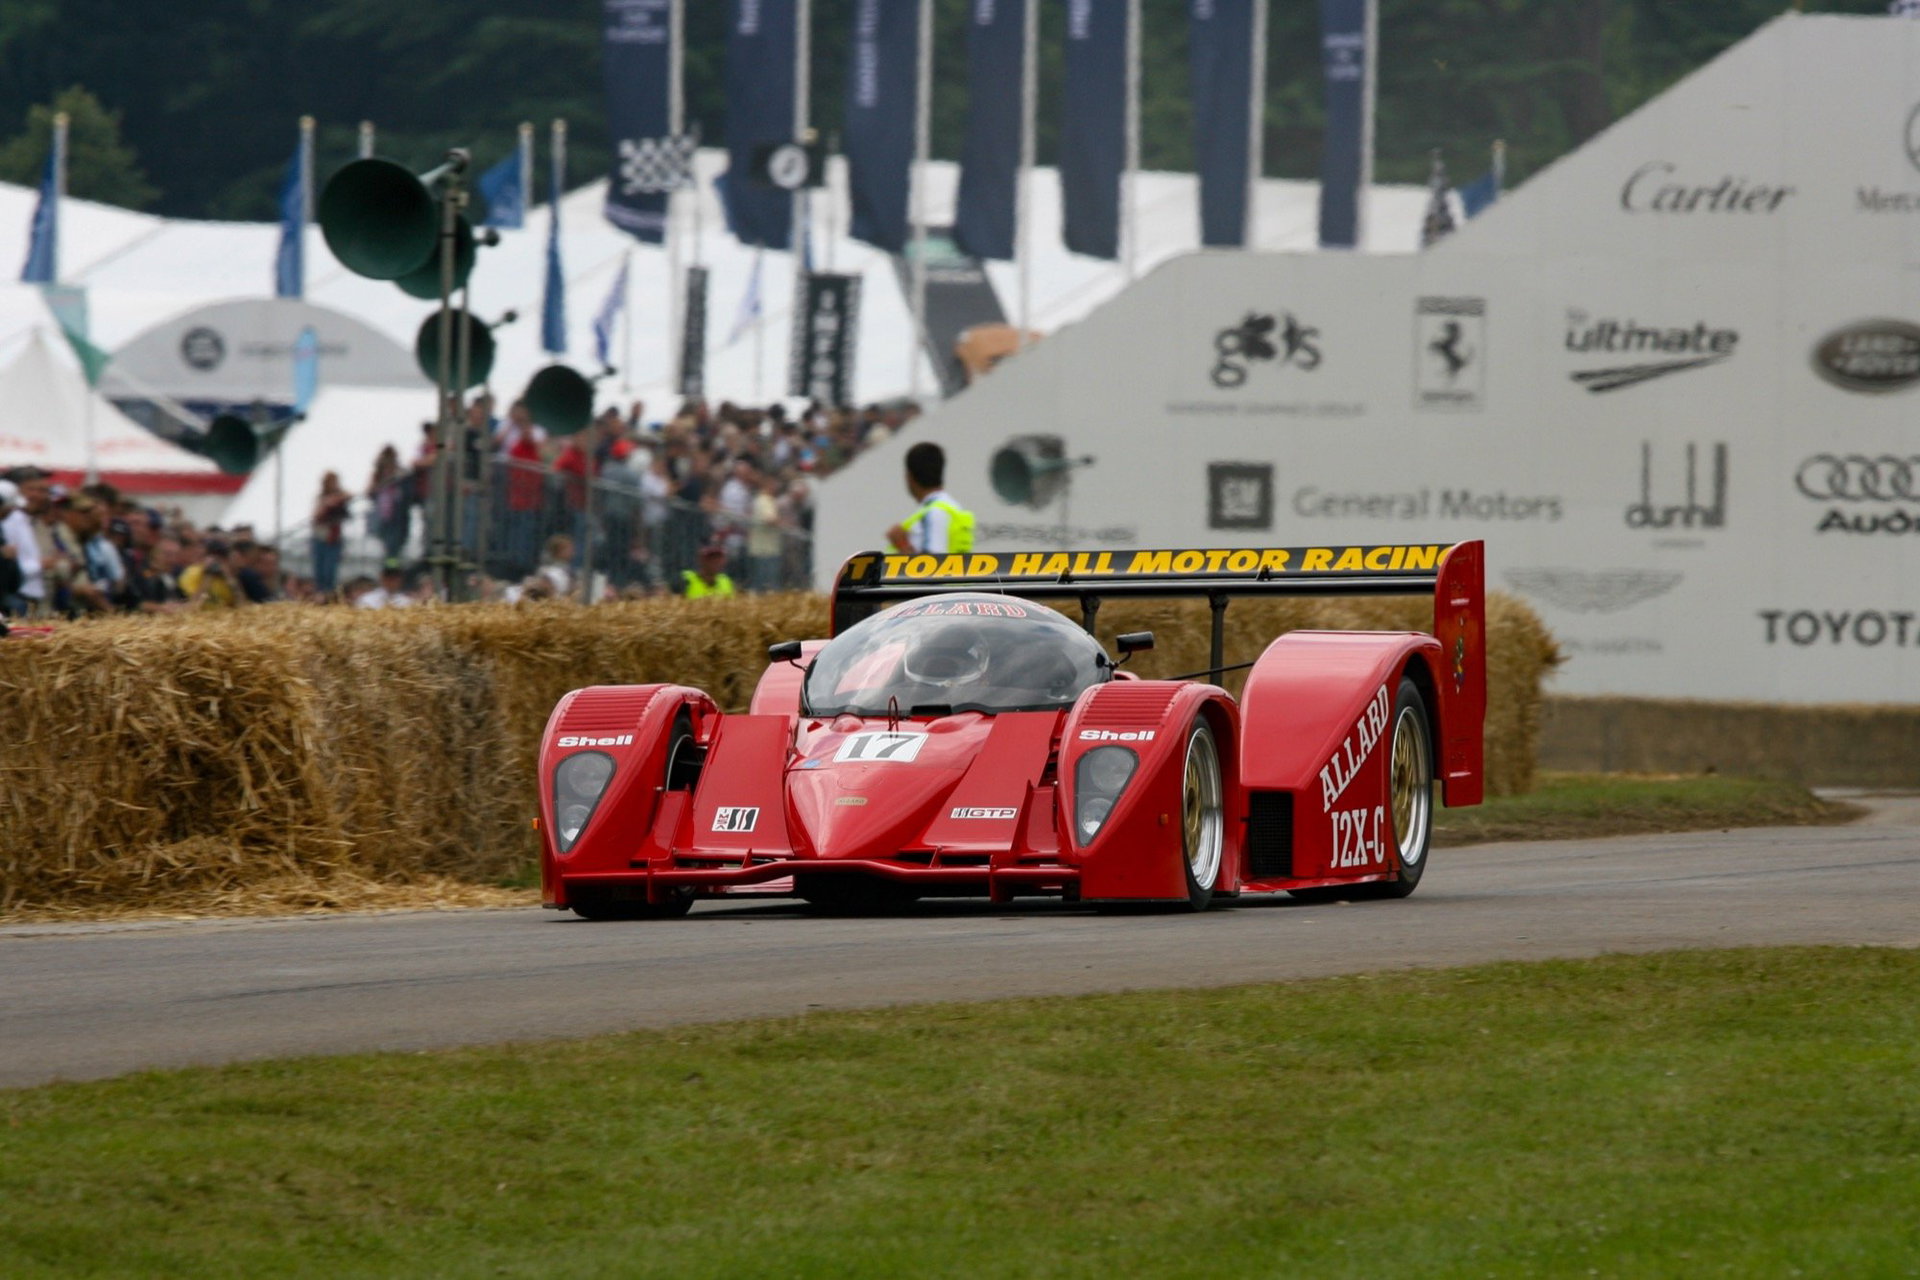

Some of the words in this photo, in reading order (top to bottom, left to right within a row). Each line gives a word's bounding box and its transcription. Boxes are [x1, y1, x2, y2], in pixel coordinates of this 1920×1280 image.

[1619, 160, 1796, 213] Cartier
[1566, 320, 1740, 352] ultimate
[1293, 485, 1431, 520] General
[1438, 488, 1564, 523] Motors
[883, 554, 999, 579] TOAD
[1007, 552, 1115, 577] HALL
[1126, 549, 1291, 575] MOTOR
[1757, 610, 1920, 647] TOYOT
[557, 734, 633, 748] Shell
[847, 734, 917, 759] 17
[1079, 730, 1155, 741] Shell
[1318, 683, 1390, 814] ALLARD
[969, 809, 1014, 817] GTP
[1329, 805, 1386, 870] J2X-C
